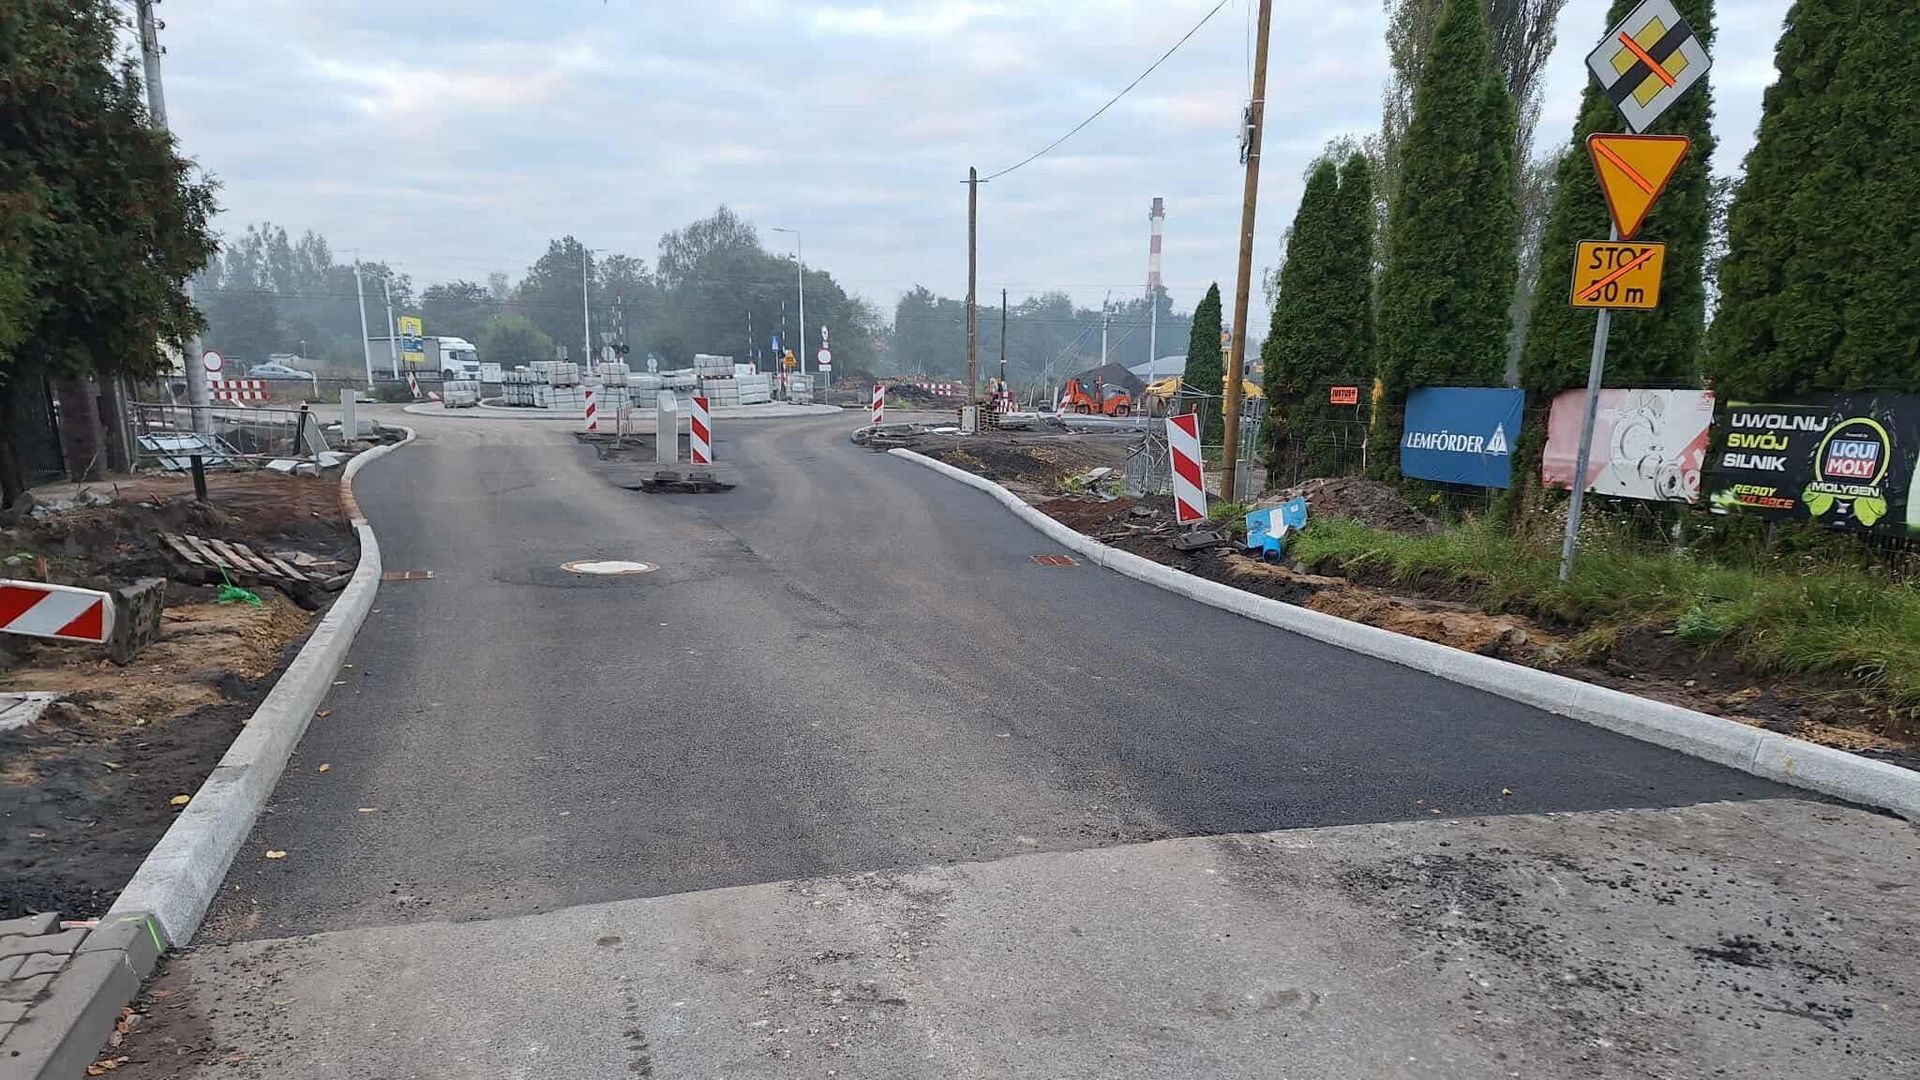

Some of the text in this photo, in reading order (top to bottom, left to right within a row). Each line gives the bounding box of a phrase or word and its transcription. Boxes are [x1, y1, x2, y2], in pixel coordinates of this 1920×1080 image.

[1589, 247, 1653, 270] STOP
[1625, 288, 1644, 303] m
[1731, 413, 1828, 431] UWOLNIJ
[1406, 430, 1484, 453] LEMFÖRDER
[1727, 430, 1789, 451] SWÓJ
[1832, 442, 1876, 459] LIQUI
[1722, 453, 1787, 472] SILNIK
[1827, 459, 1873, 475] MOLY
[1734, 484, 1777, 497] READY
[1812, 482, 1879, 497] MOLYGEN
